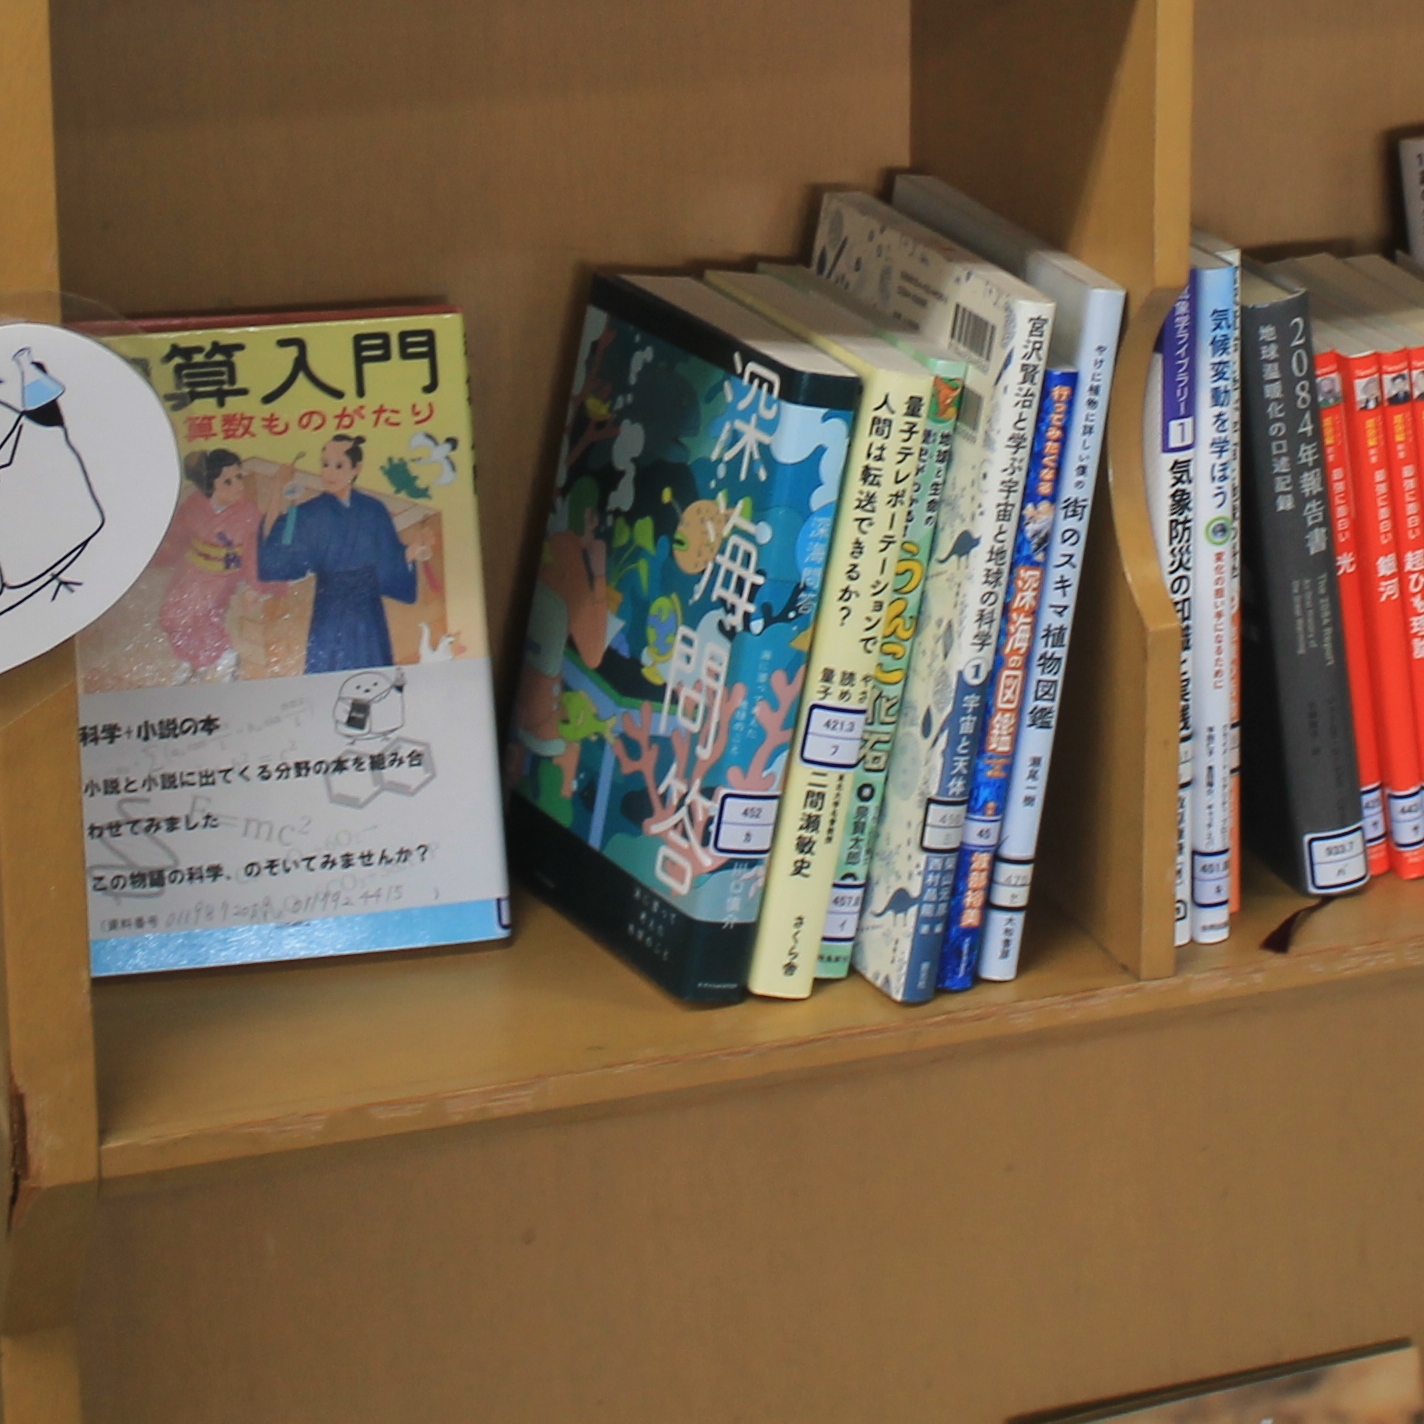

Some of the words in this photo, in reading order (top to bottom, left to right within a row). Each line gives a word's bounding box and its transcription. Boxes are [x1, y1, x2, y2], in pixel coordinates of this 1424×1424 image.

[132, 328, 439, 411] 算入門
[183, 402, 435, 442] 算数ものがたり
[1209, 308, 1232, 509] 気候変動を学ぼう
[1258, 324, 1295, 513] 地球温暖化の口述記録
[971, 315, 1051, 652] 宮沢賢治と学ぶ宇宙と地球の科学
[1036, 384, 1073, 497] 行ってみたくなる
[1289, 317, 1327, 555] 2084年報告書
[859, 396, 924, 654] 量子テレポーテーションで
[1336, 552, 1358, 576] 光
[1375, 555, 1401, 603] 銀河
[649, 351, 781, 895] 深海問答
[863, 540, 924, 773] うんこ化石
[984, 565, 1043, 755] 深海の図鑑
[1027, 496, 1088, 730] 街のスキマ植物図鑑
[947, 693, 980, 797] 宇宙と天体
[87, 812, 219, 840] わせてみました
[741, 806, 763, 820] 452
[788, 770, 828, 879] 二間瀬敏史
[782, 915, 804, 977] さくら舎
